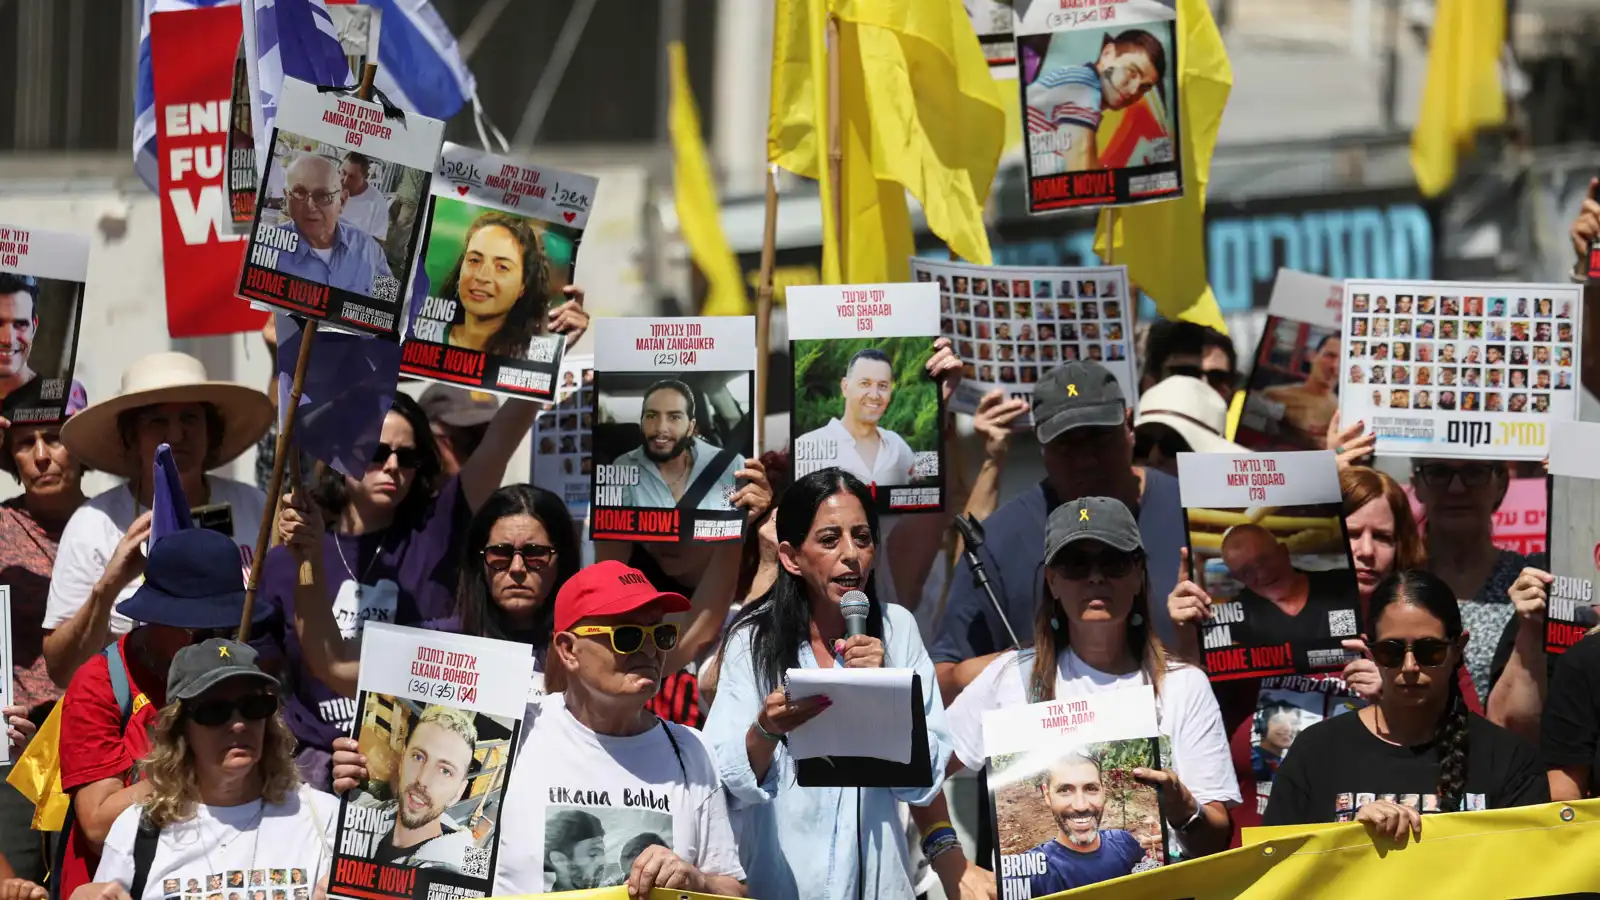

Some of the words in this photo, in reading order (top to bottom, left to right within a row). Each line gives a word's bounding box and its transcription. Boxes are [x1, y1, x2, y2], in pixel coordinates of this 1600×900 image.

[337, 99, 356, 117] קופר
[357, 105, 384, 124] עמירם
[322, 110, 357, 130] AMIRAM
[359, 120, 392, 140] COOPER
[345, 129, 363, 147] (85)
[485, 174, 510, 190] INBAR
[511, 182, 546, 199] HAYMAN
[1033, 176, 1070, 201] HOME
[1073, 169, 1117, 196] NOW!
[502, 192, 520, 208] (27)
[12, 230, 30, 243] דרור
[255, 222, 299, 253] BRING
[0, 242, 15, 253] ROR
[17, 243, 28, 255] OR
[251, 243, 279, 270] HIM
[2, 254, 18, 267] (48)
[245, 267, 287, 297] HOME
[288, 279, 331, 309] NOW!
[842, 291, 867, 304] שרעבי
[869, 290, 884, 303] יוסי
[341, 308, 370, 323] FAMILIES
[370, 316, 393, 330] FORUM
[418, 296, 457, 323] RING
[836, 304, 855, 317] YOSI
[857, 303, 892, 316] SHARABI
[686, 323, 702, 337] מתן
[857, 317, 873, 331] (53)
[636, 338, 664, 350] MATAN
[667, 337, 714, 350] ZANGAUKER
[403, 341, 441, 369] HOME
[443, 349, 487, 377] NOW!
[654, 353, 677, 366] (25)
[1441, 420, 1492, 448] נקום.
[1495, 421, 1545, 446] נחזיר.
[796, 438, 838, 460] BRING
[596, 464, 640, 486] BRING
[1264, 460, 1276, 472] מני
[1227, 474, 1248, 486] MENY
[1252, 473, 1285, 486] GODARD
[596, 486, 623, 506] HIM
[1249, 487, 1266, 500] (73)
[594, 509, 634, 531] HOME
[638, 509, 679, 533] NOW!
[618, 573, 646, 586] NOW
[1203, 601, 1245, 626] RING
[1548, 597, 1575, 622] HIM
[1203, 625, 1232, 650] HIM
[417, 645, 444, 665] בוחבוט
[447, 651, 477, 671] אלקנה
[1206, 648, 1248, 673] HOME
[1250, 642, 1294, 668] NOW!
[411, 661, 440, 681] ELKANA
[442, 667, 480, 686] BOHBOT
[408, 678, 429, 697] (36)
[430, 683, 455, 701] (35)
[457, 687, 477, 704] (34)
[1047, 703, 1065, 717] אדר
[1068, 700, 1088, 714] תמיר
[1041, 714, 1069, 729] TAMIR
[1071, 712, 1095, 725] ADAR
[549, 786, 612, 807] Elkana
[623, 788, 670, 812] Bohbot
[344, 802, 391, 835] BRING
[340, 829, 371, 859] HIM
[335, 857, 377, 889] HOME
[377, 866, 416, 894] NOW!
[1001, 852, 1047, 878] BRING
[429, 882, 454, 894] HOSTAGES
[454, 887, 464, 896] AND
[1002, 878, 1031, 900] HIM
